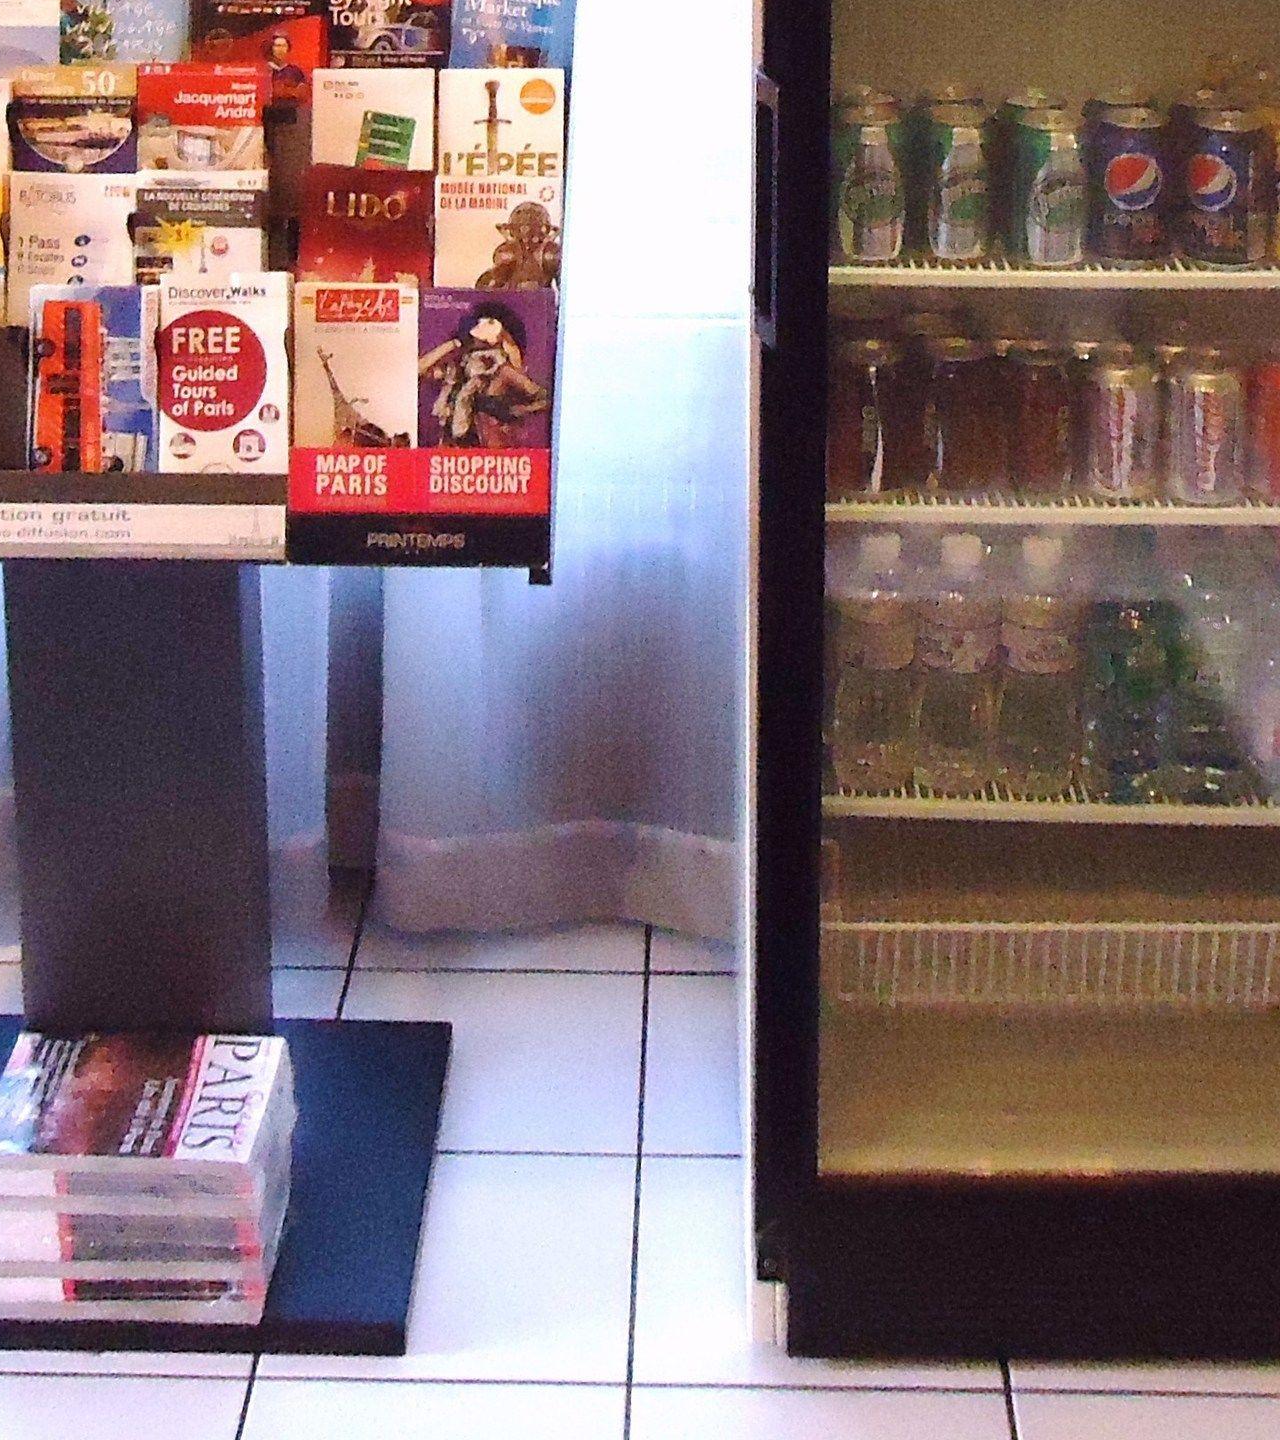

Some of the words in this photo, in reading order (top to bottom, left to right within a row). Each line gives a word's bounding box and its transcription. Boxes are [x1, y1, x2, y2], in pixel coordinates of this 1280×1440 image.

[174, 91, 257, 106] Jacquemart
[326, 190, 407, 220] LIDO
[171, 326, 241, 355] FREE
[172, 364, 238, 382] Guided
[172, 383, 217, 399] Tours
[172, 401, 189, 417] of
[193, 400, 234, 417] Paris
[316, 454, 361, 474] MAP
[363, 454, 388, 474] OF
[429, 455, 532, 476] SHOPPING
[316, 473, 388, 496] PARIS
[429, 474, 531, 495] DISCOUNT
[181, 1037, 264, 1158] PARIS
